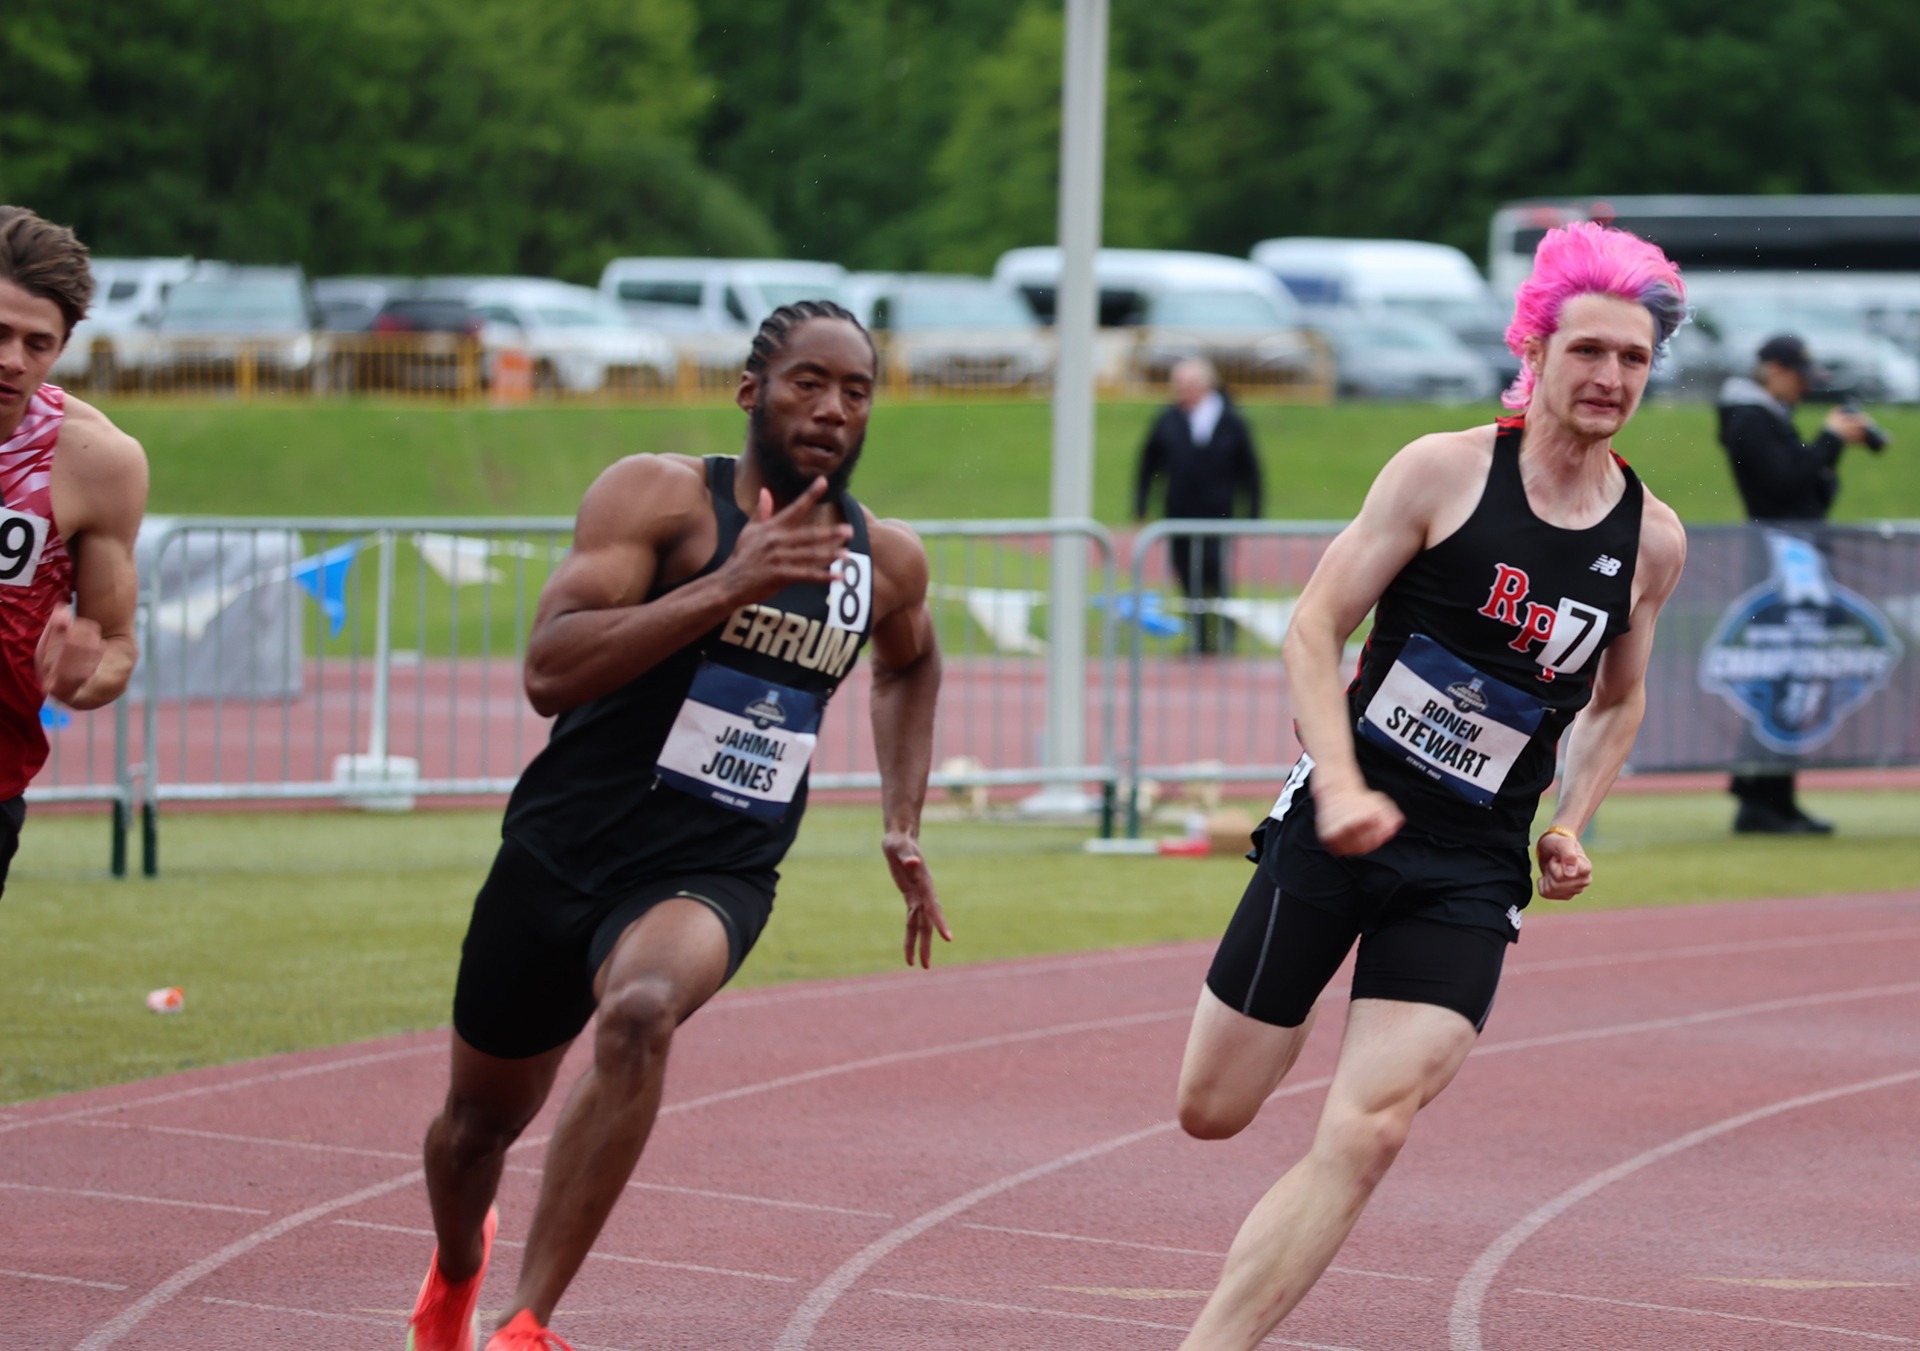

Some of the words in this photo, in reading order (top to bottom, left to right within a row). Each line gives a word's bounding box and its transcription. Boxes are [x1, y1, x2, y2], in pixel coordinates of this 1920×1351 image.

[0, 517, 35, 580] 9
[838, 558, 860, 625] 8
[1478, 562, 1557, 683] RP
[719, 603, 860, 678] ERRUM
[1551, 606, 1598, 668] 7
[715, 726, 787, 761] JAHMAL
[1386, 706, 1491, 778] STEWART
[1421, 699, 1483, 742] RONEN
[701, 752, 777, 793] JONES
